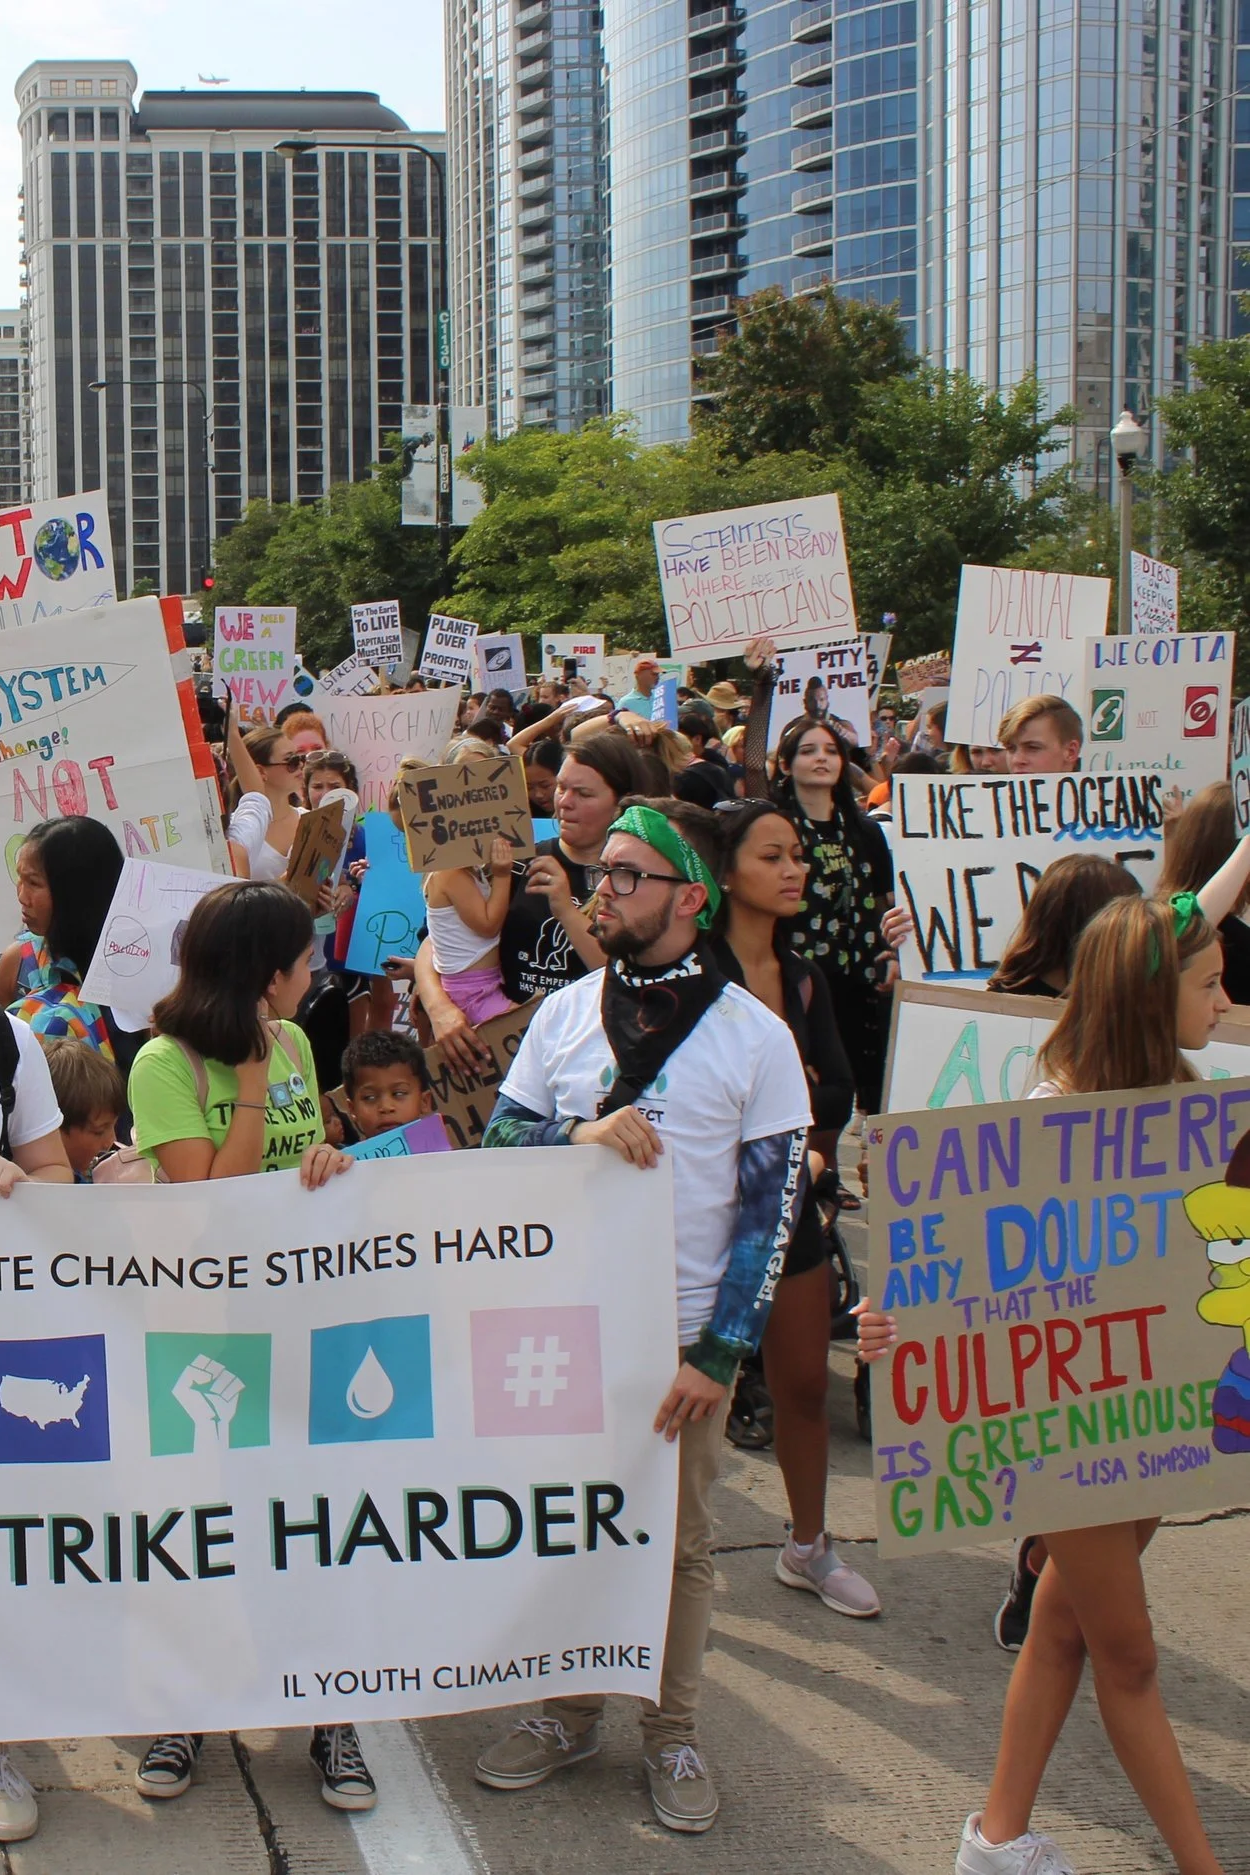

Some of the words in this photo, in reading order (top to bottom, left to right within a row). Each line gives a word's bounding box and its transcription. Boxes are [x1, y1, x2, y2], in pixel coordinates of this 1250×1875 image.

[439, 312, 450, 367] C1130
[662, 514, 811, 557] SCIENTISTS
[664, 556, 711, 579] HAVE
[721, 544, 783, 572] BEEN
[786, 531, 839, 560] READY
[1142, 559, 1170, 584] DIBS
[682, 573, 746, 600] WHERE
[751, 574, 774, 587] ARE
[776, 567, 805, 583] THE
[1136, 584, 1174, 610] KEEPING
[1149, 579, 1159, 589] ON
[366, 607, 378, 615] The
[379, 605, 398, 614] Earth
[670, 572, 849, 648] POLITICIANS
[989, 568, 1074, 640] DENIAL
[219, 613, 255, 642] WE
[260, 613, 286, 624] NEED
[261, 627, 272, 639] A
[355, 619, 368, 633] To
[370, 615, 398, 631] LIVE
[431, 617, 477, 637] PLANET
[435, 632, 466, 649] OVER
[356, 635, 400, 647] CAPITALISM
[357, 648, 379, 658] Must
[380, 644, 401, 655] END!
[573, 646, 596, 654] FIRE
[1095, 639, 1128, 668] WE
[1134, 635, 1226, 666] GOTTA
[218, 647, 284, 673] GREEN
[423, 651, 469, 671] PROFITS!
[816, 647, 863, 669] PITY
[229, 676, 288, 707] NEW
[827, 672, 867, 690] FUEL
[328, 710, 419, 744] MARCH
[1137, 711, 1159, 728] NOT
[14, 755, 119, 822] NOT
[418, 779, 509, 814] ENDANGERED
[899, 783, 984, 840] LIKE
[981, 779, 1052, 839] THE
[1056, 775, 1164, 830] OCEANS
[431, 813, 501, 846] SPECIES
[899, 865, 999, 973] WE
[110, 941, 149, 958] POLLUTION
[519, 982, 534, 994] HAS
[520, 972, 537, 983] THE
[279, 1106, 297, 1123] IS
[295, 1097, 316, 1120] NO
[1043, 1090, 1250, 1185] THERE
[882, 1258, 963, 1311] ANY
[986, 1189, 1185, 1293] DOUBT
[890, 1213, 947, 1264] BE
[50, 1253, 250, 1291] CHANGE
[265, 1232, 417, 1287] STRIKES
[433, 1222, 554, 1266] HARD
[953, 1286, 1037, 1330] THAT
[1043, 1275, 1097, 1313] THE
[891, 1305, 1167, 1426] CULPRIT
[877, 1440, 932, 1483] IS
[947, 1379, 1219, 1478] GREENHOUSE
[1138, 1445, 1211, 1479] SIMPSON
[268, 1480, 652, 1573] HARDER.
[282, 1675, 306, 1699] IL
[314, 1667, 423, 1698] YOUTH
[432, 1654, 551, 1692] CLIMATE
[560, 1644, 653, 1673] STRIKE
